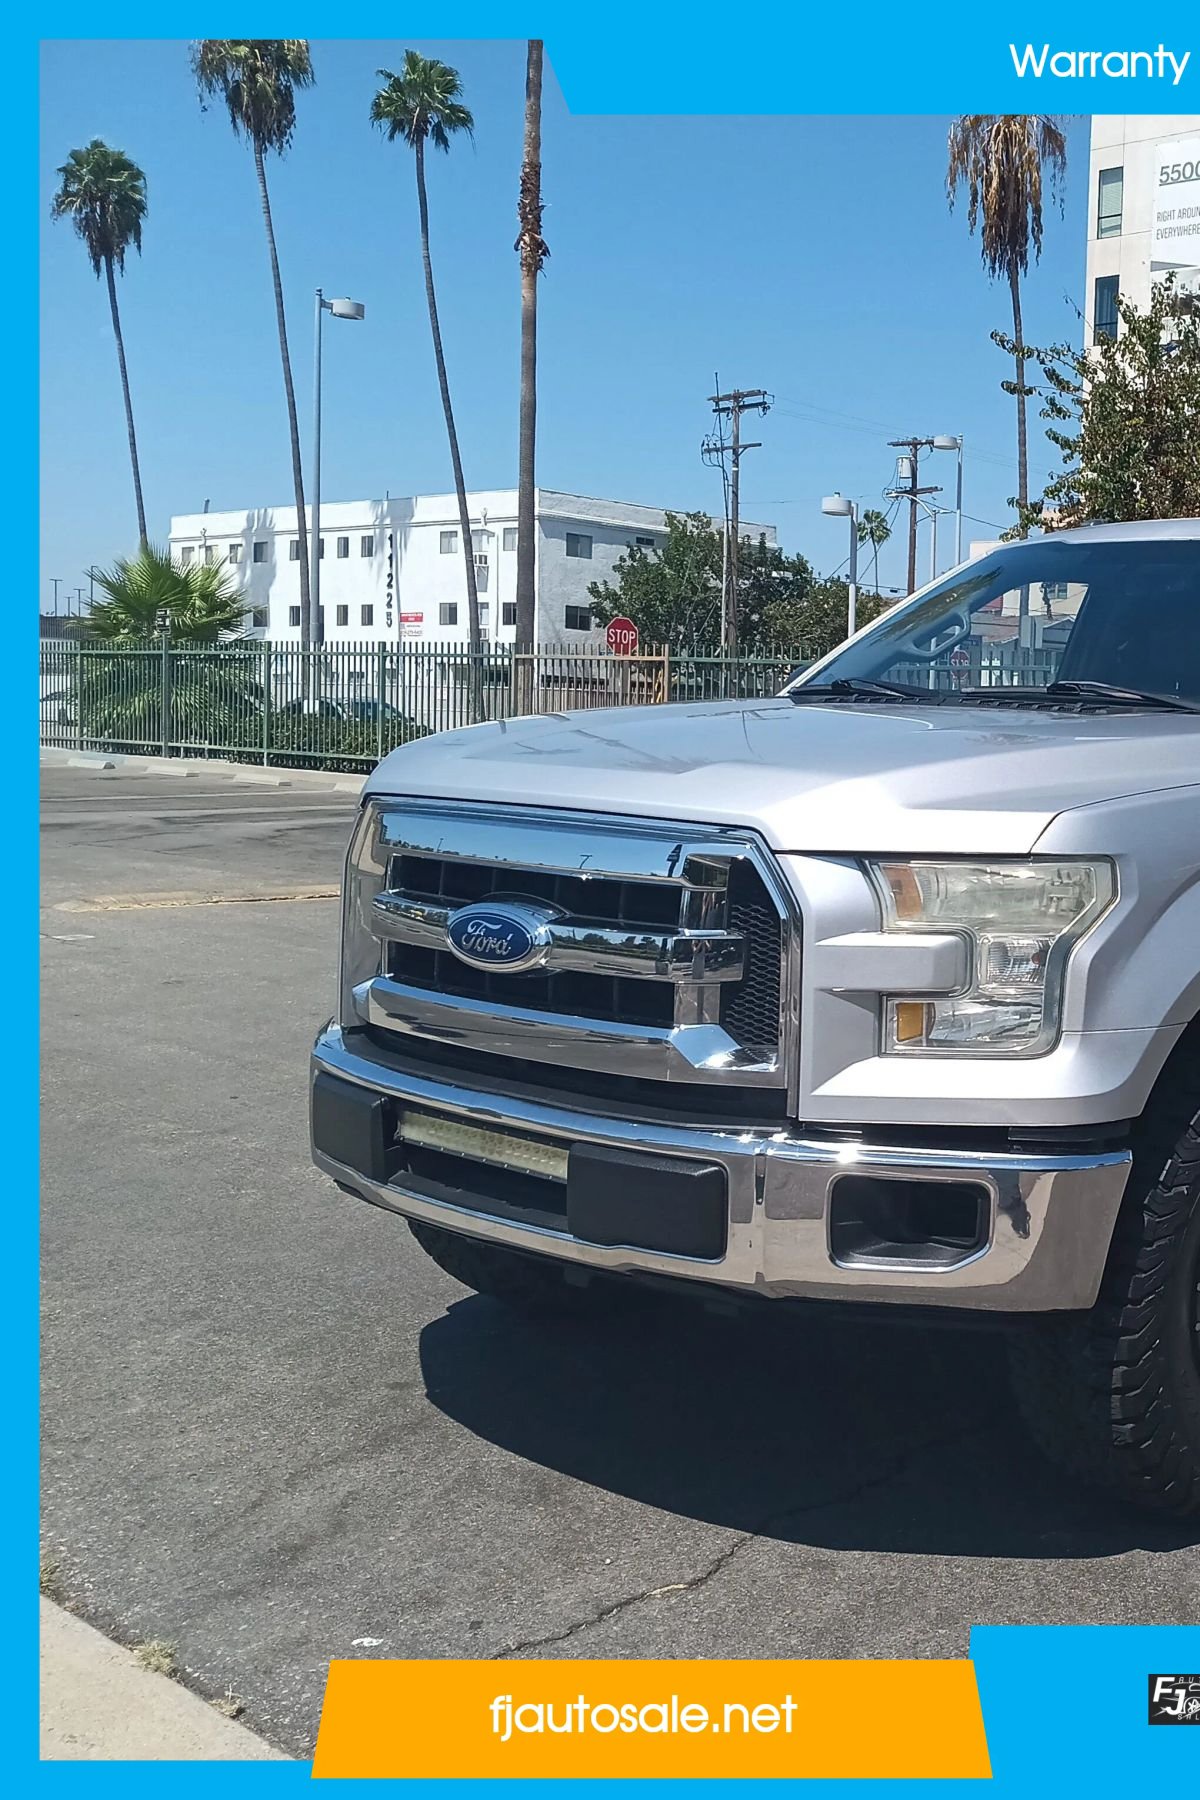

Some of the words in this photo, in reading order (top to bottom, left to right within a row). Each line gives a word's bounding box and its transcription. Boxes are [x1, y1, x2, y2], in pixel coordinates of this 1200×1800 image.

[1156, 209, 1176, 222] RIGHT
[1156, 223, 1200, 241] EVERYWHERE
[608, 628, 636, 644] STOP
[461, 919, 514, 956] Ford
